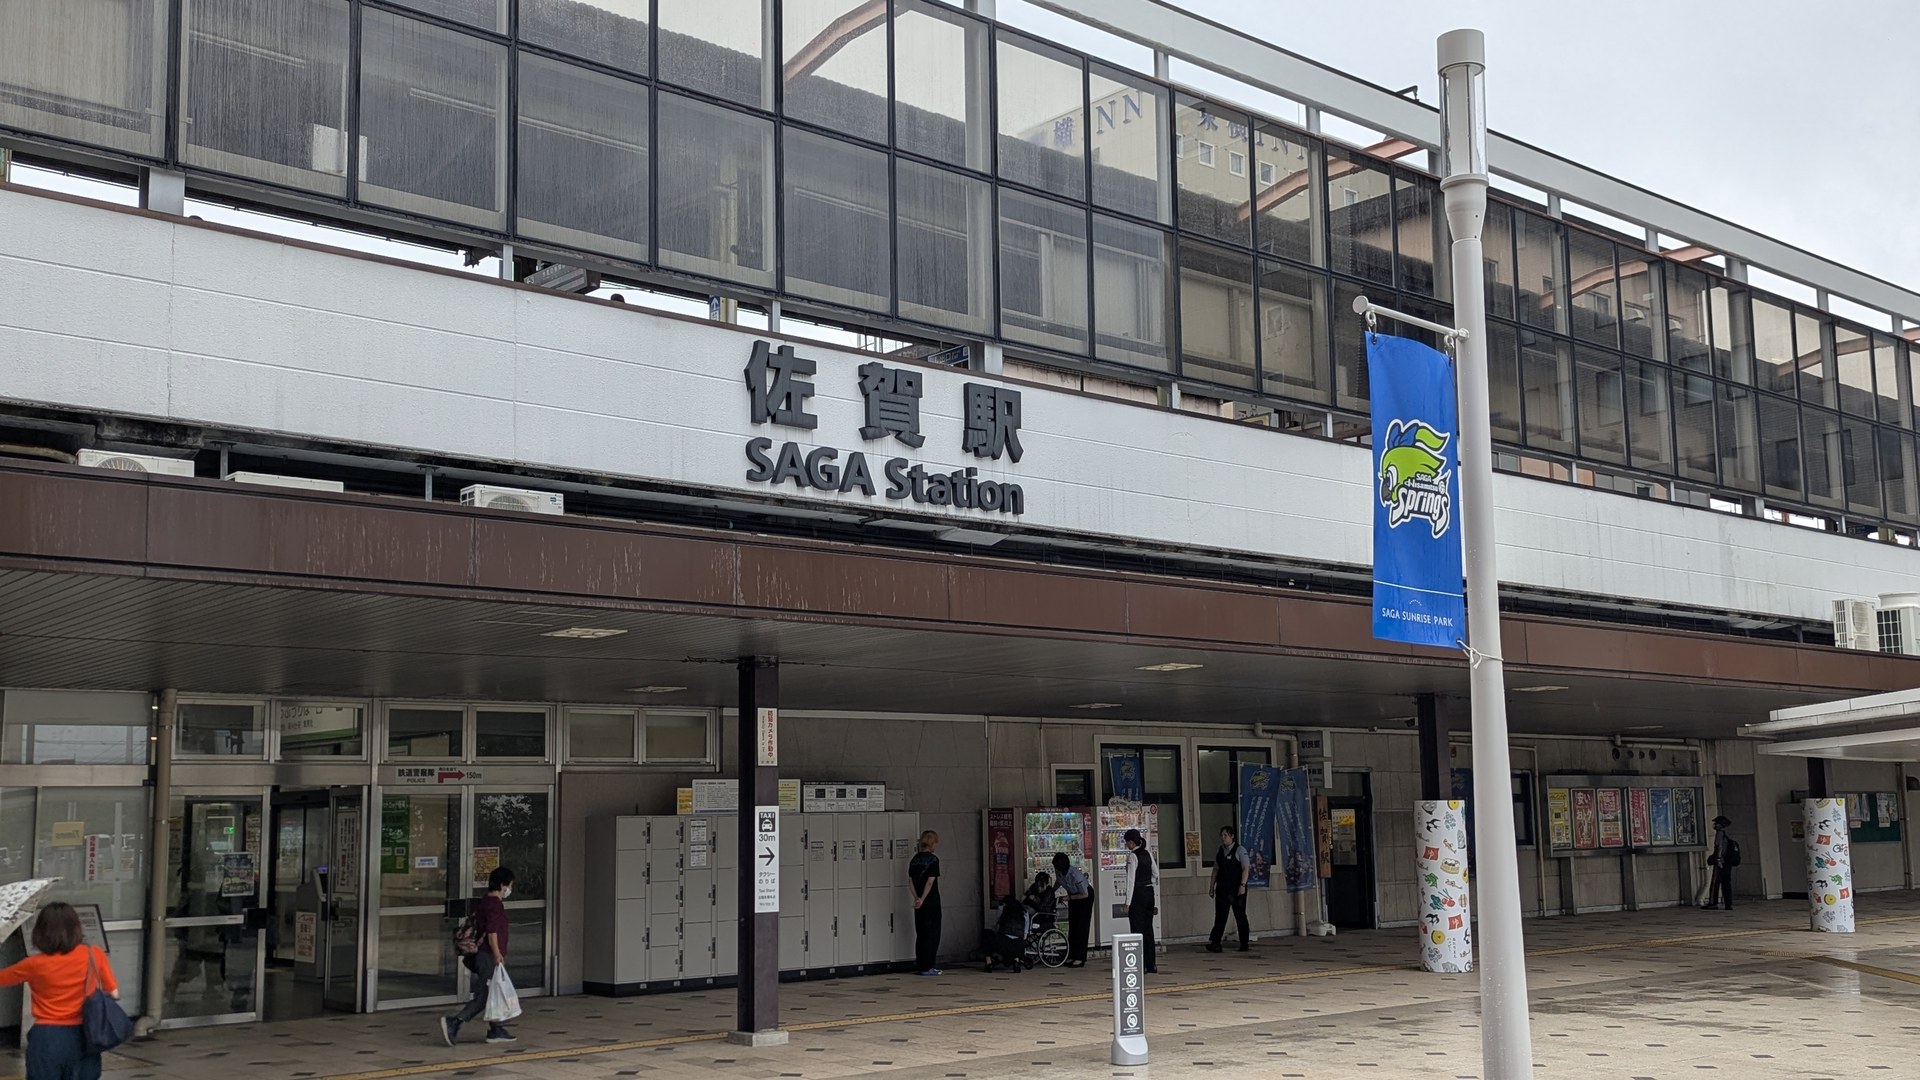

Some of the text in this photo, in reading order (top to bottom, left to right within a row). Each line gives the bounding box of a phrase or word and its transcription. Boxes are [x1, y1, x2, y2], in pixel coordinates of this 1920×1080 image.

[744, 339, 1024, 463] 佐賀駅
[745, 436, 1024, 515] SAGA Station
[1415, 472, 1433, 483] SAGA
[1391, 487, 1449, 537] Springs
[1381, 607, 1453, 627] SAGA SUNRISE PARK
[466, 771, 482, 779] 150m
[758, 833, 776, 842] 30m
[1318, 808, 1330, 865] 佐賀駅
